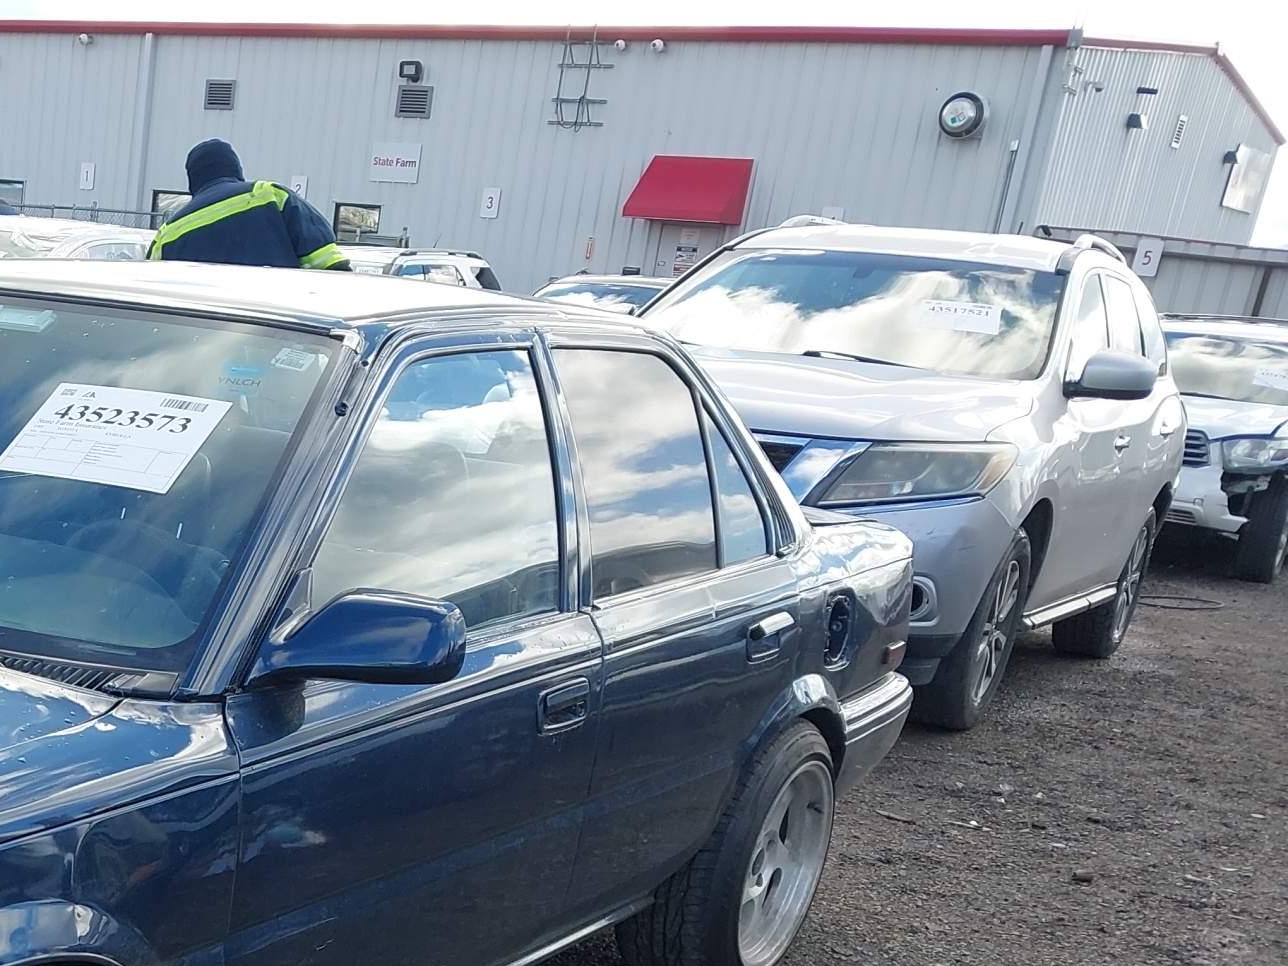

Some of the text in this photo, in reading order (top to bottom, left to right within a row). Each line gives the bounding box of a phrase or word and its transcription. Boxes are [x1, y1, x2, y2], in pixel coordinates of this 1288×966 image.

[373, 156, 417, 168] State Farm
[486, 196, 494, 209] 3
[1142, 250, 1153, 266] 5
[54, 403, 192, 434] 43523573
